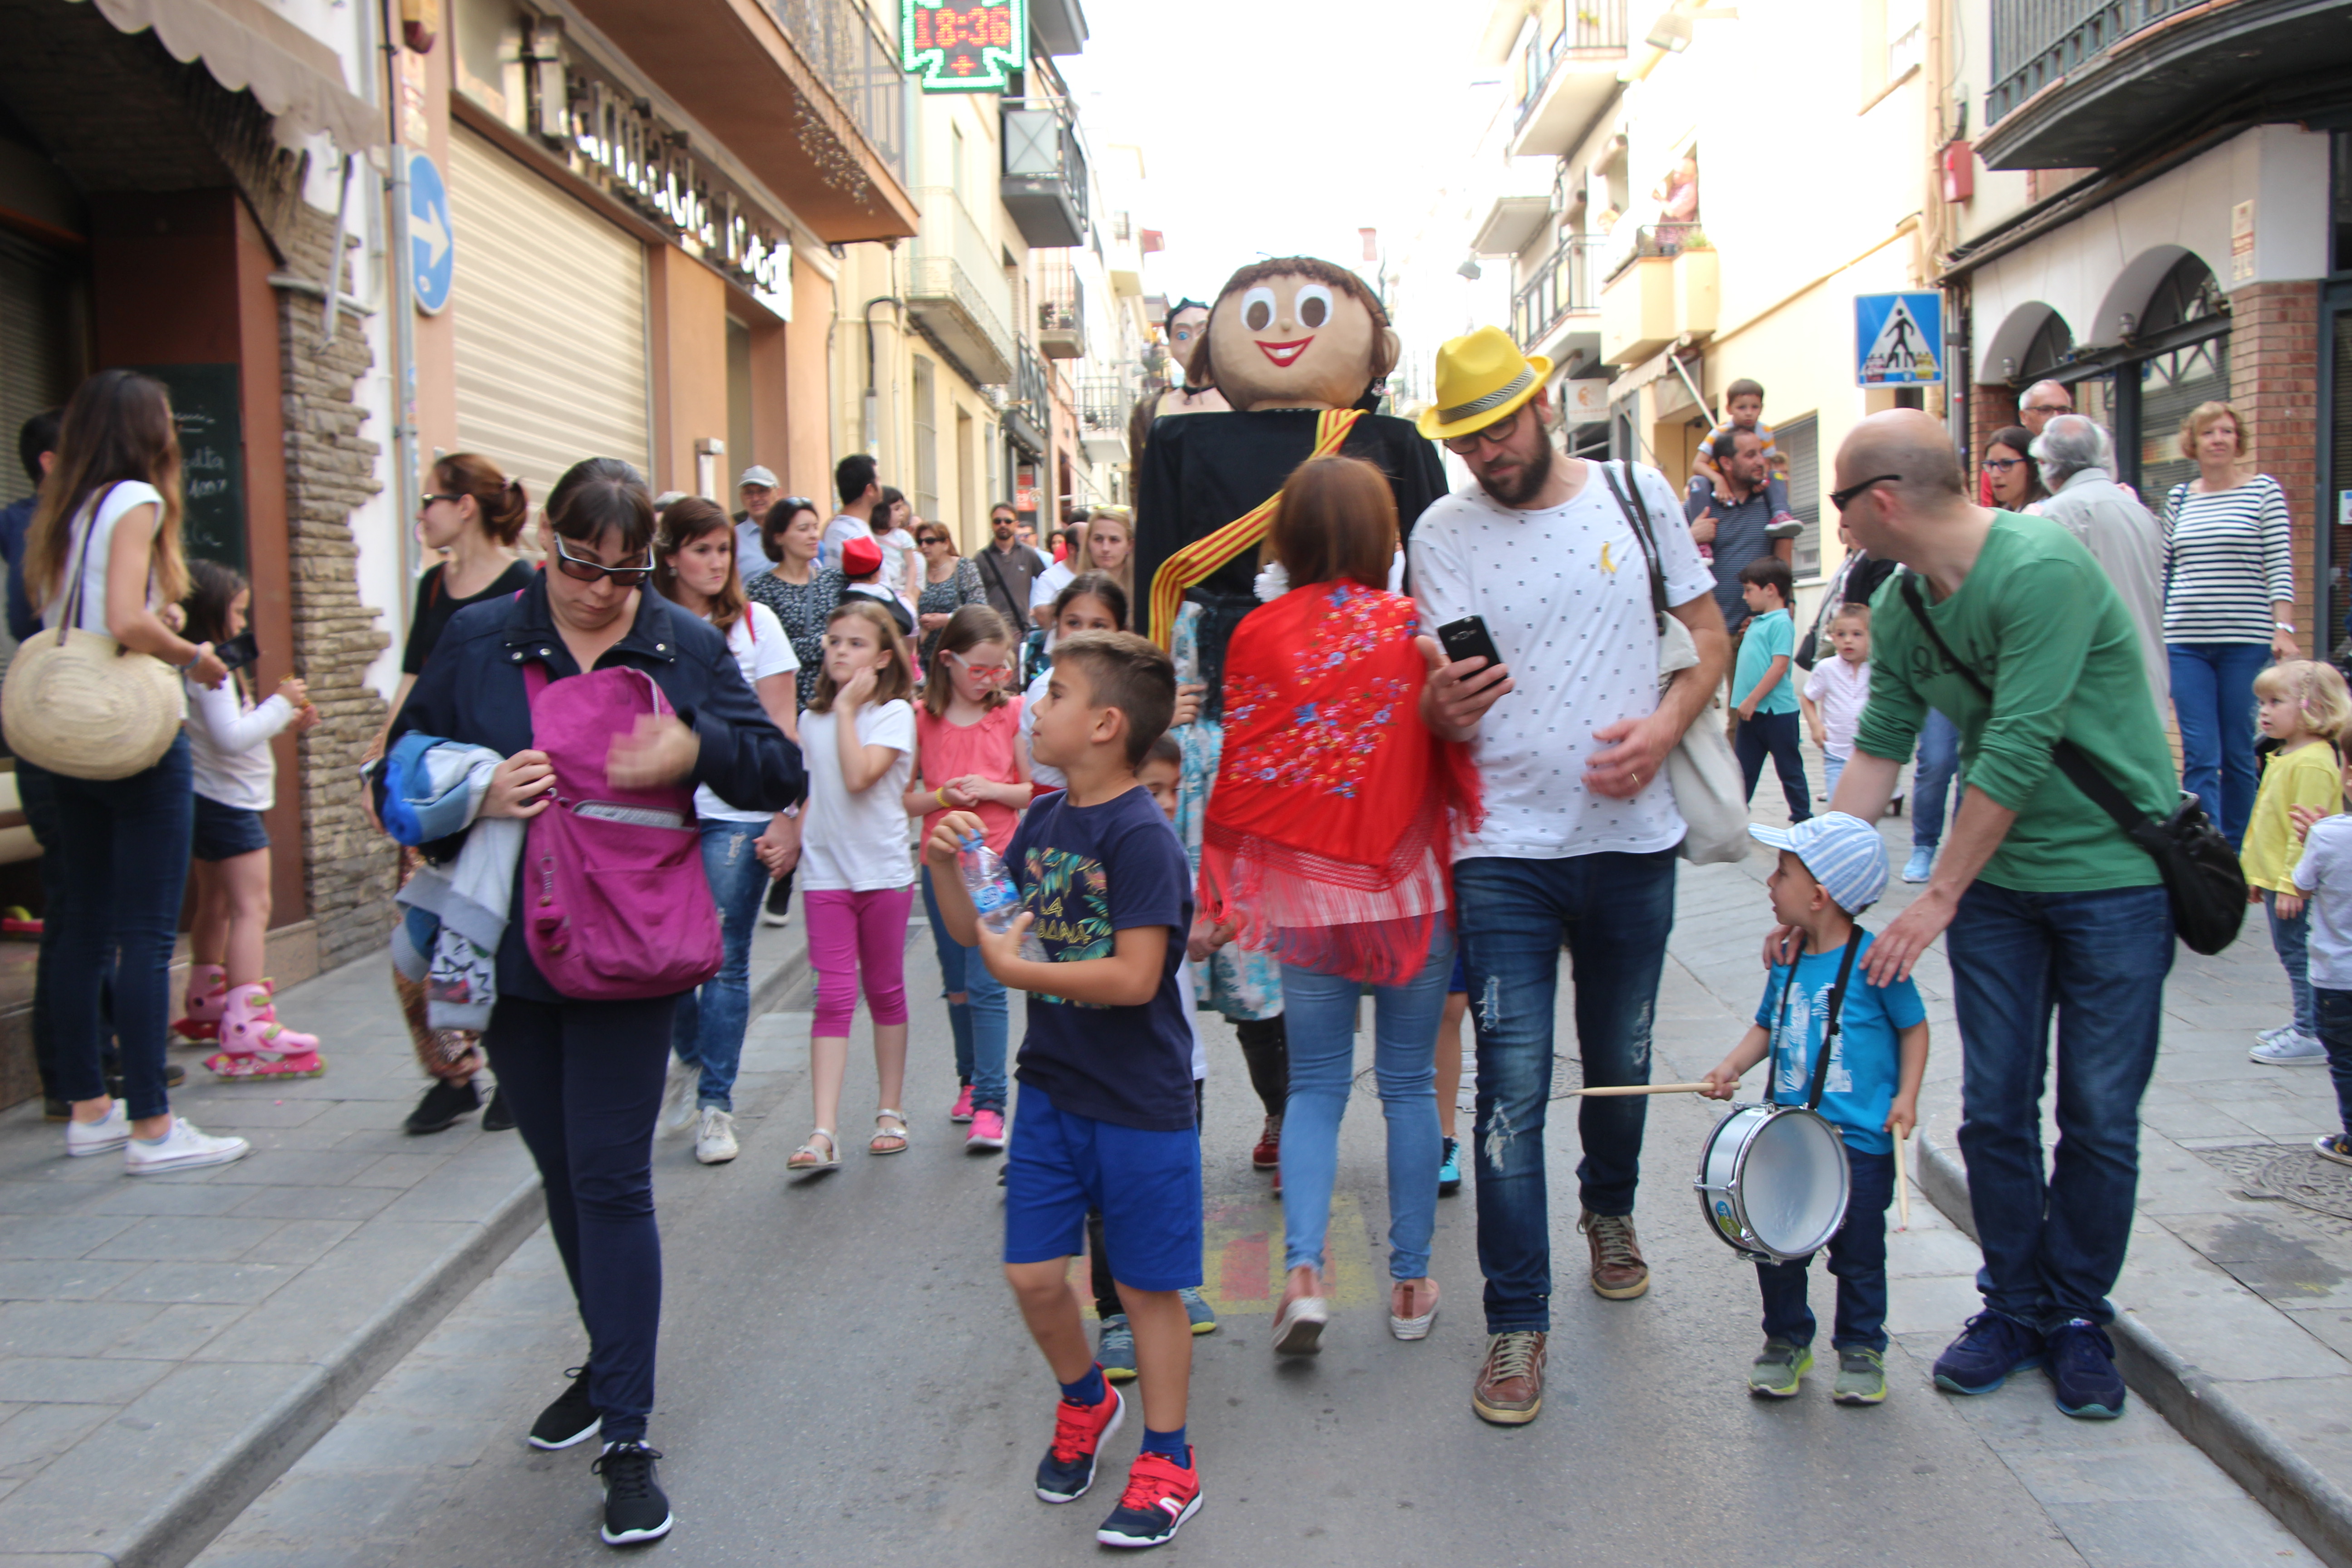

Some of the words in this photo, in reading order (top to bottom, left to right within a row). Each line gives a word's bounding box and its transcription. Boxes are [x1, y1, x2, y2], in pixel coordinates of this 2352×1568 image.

[914, 6, 1011, 48] 18:36
[1040, 894, 1063, 917] LA
[1034, 917, 1092, 945] BANA
